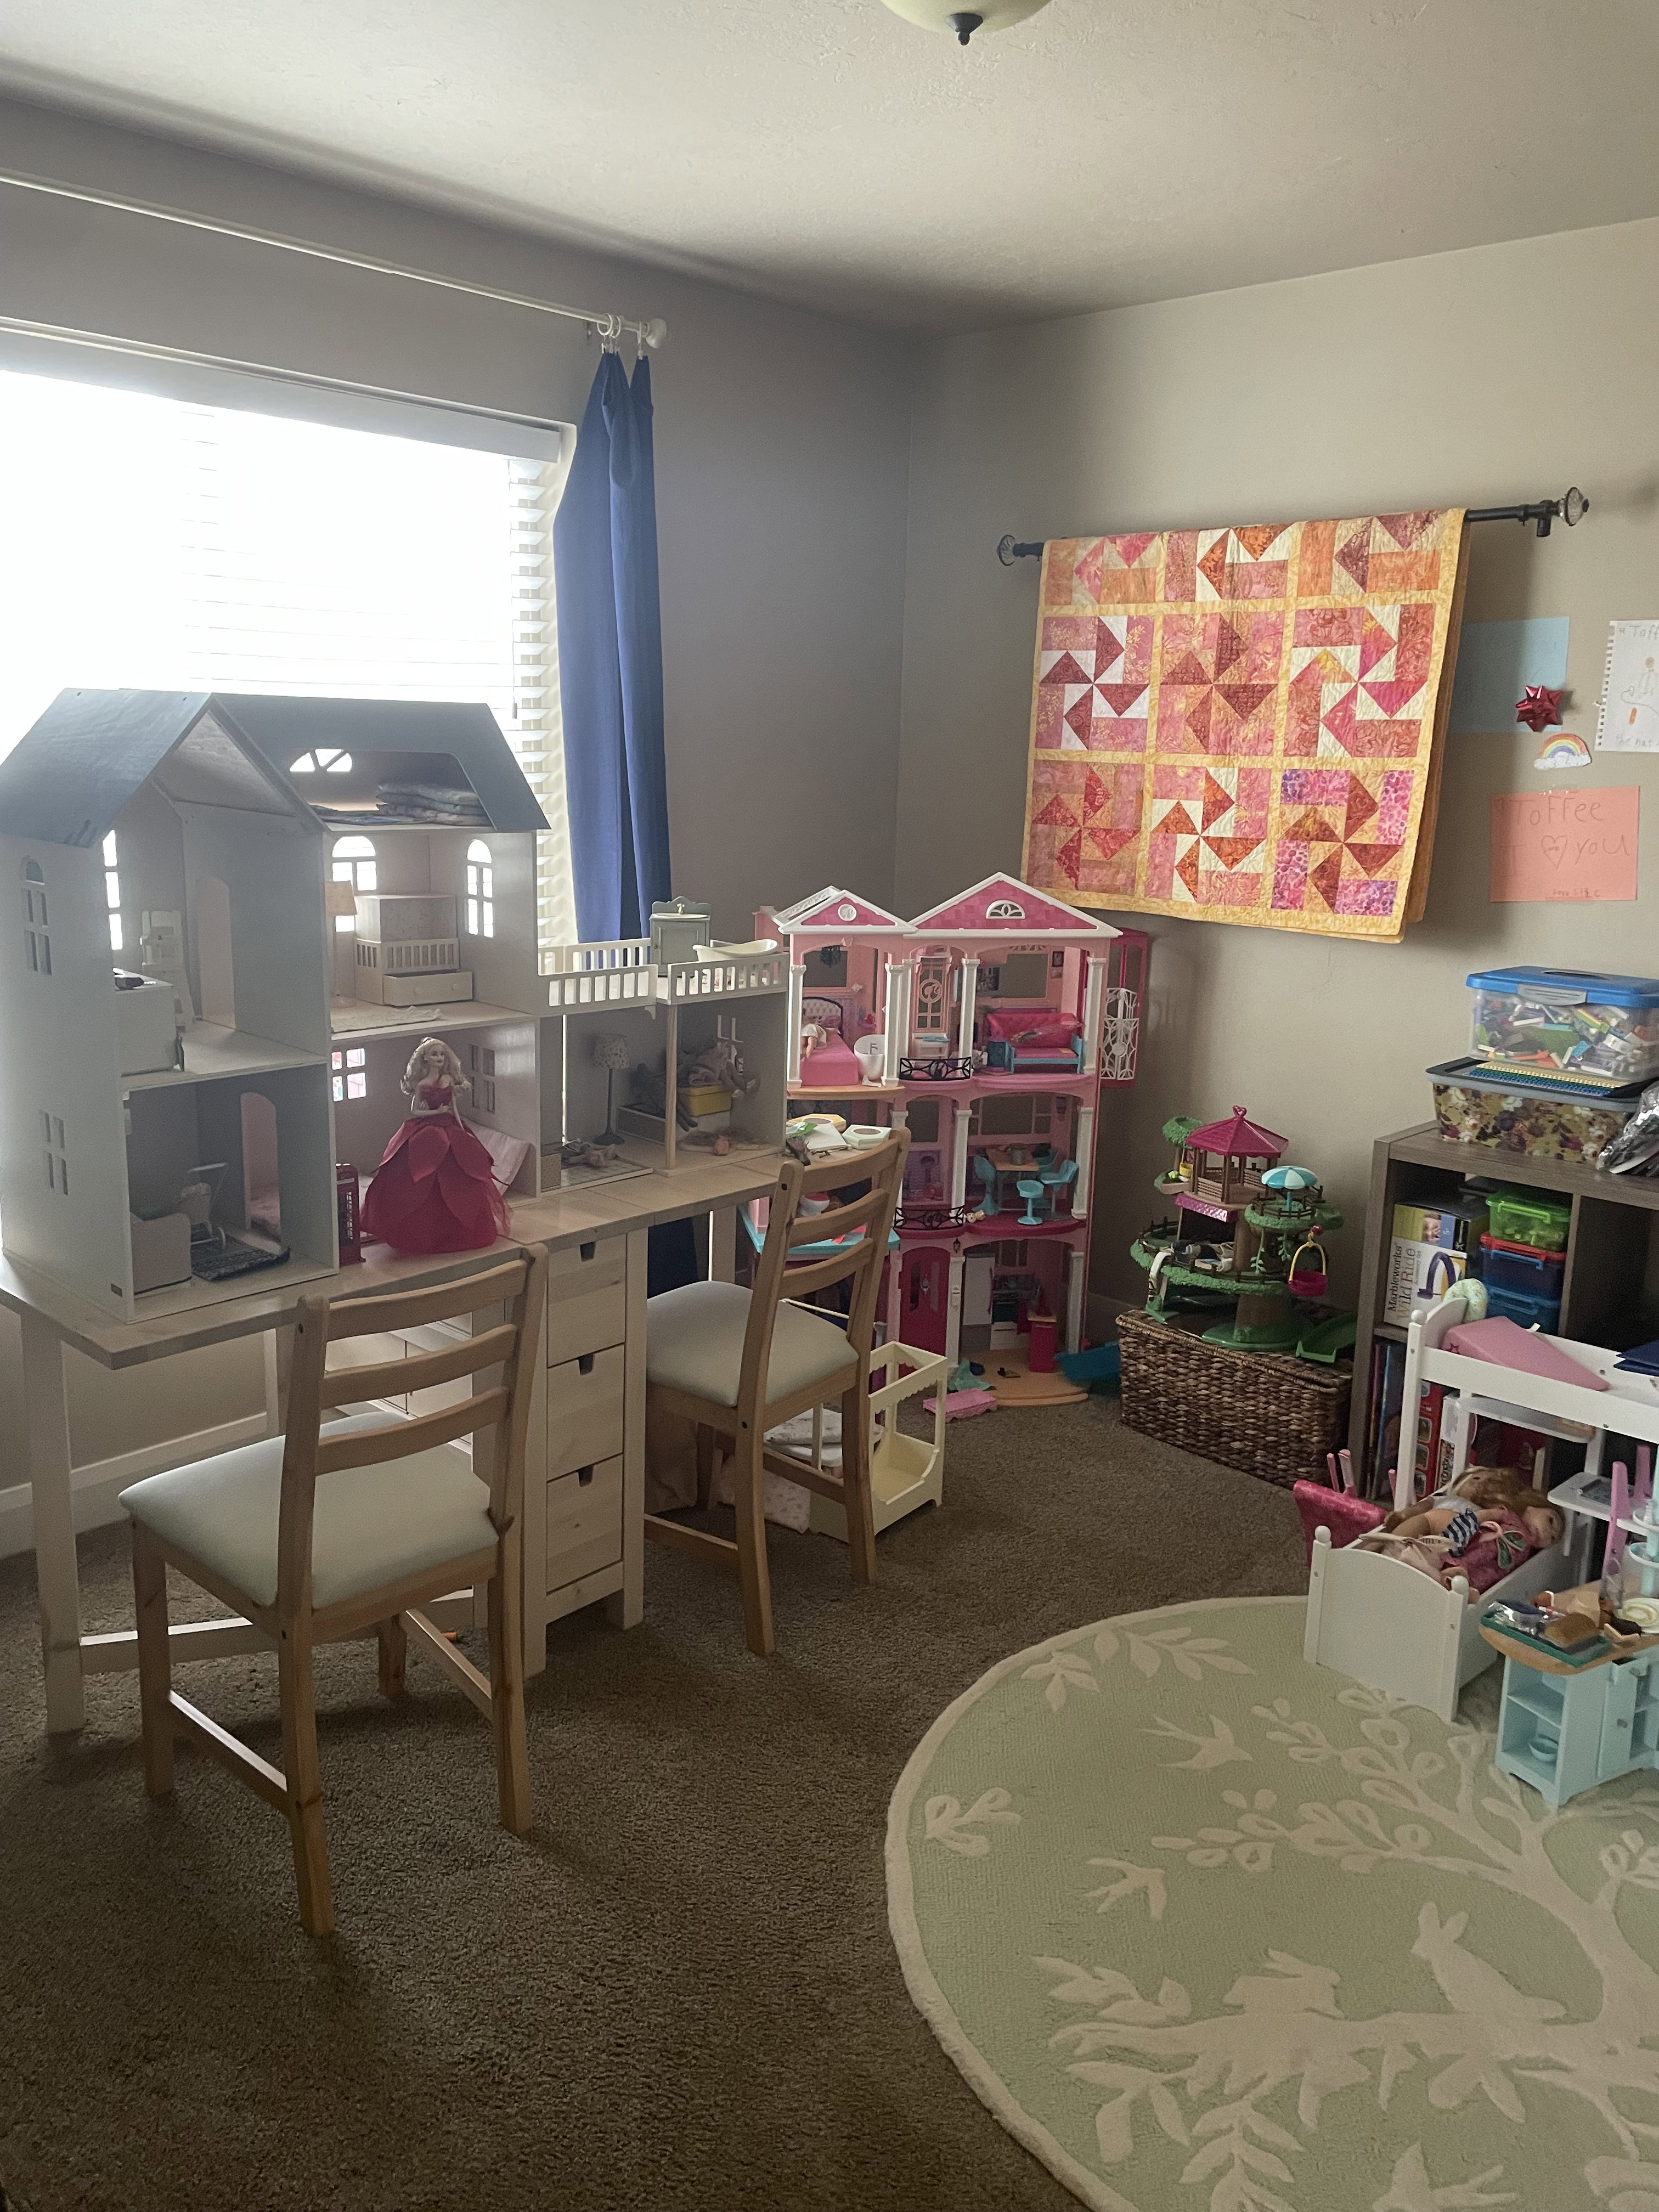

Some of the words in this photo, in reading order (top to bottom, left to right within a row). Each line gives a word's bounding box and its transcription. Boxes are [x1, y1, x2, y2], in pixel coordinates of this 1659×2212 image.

[1388, 1246, 1402, 1312] Marbleworks
[1401, 1248, 1416, 1283] Ride
[1397, 1285, 1412, 1318] Wild
